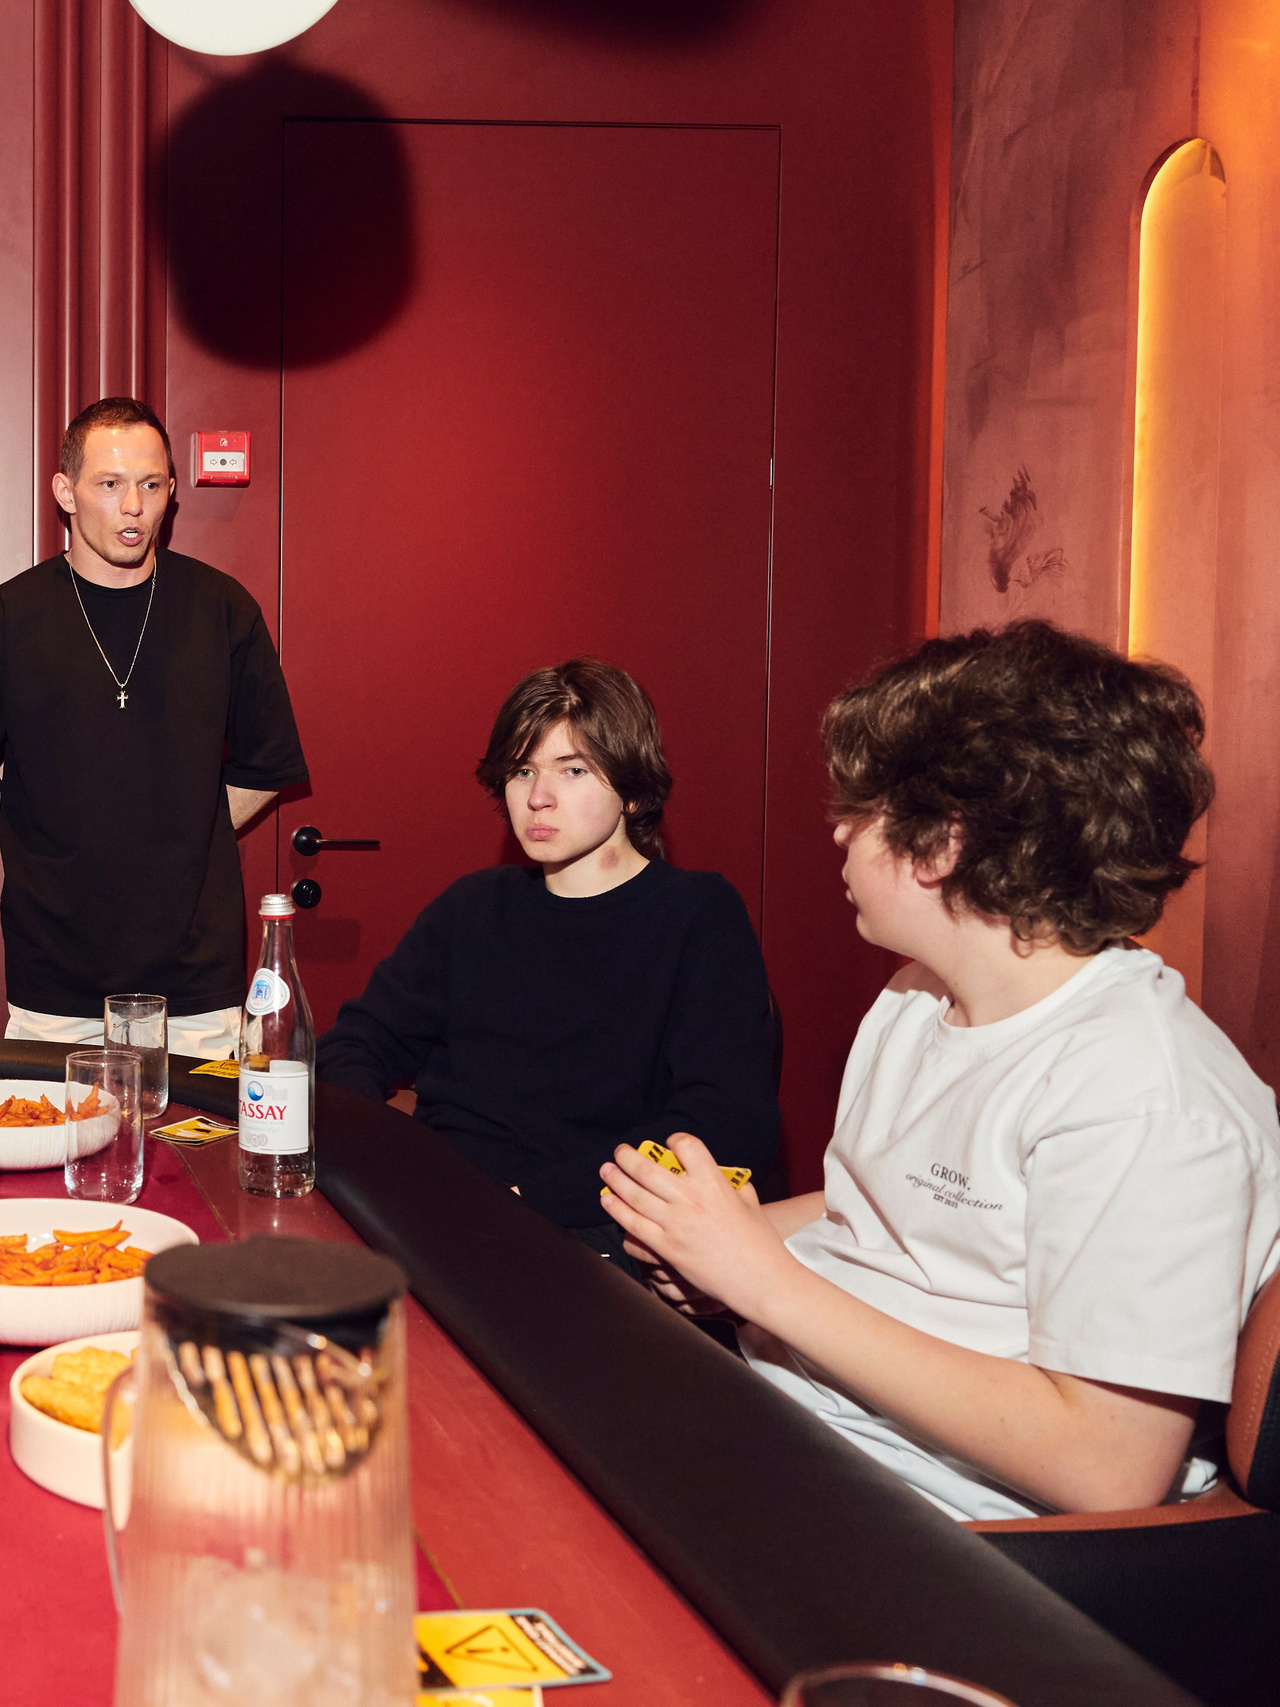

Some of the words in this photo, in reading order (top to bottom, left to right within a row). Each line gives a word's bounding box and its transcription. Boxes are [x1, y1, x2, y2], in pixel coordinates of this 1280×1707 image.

[905, 1173, 946, 1193] original
[944, 1191, 1003, 1210] collection
[931, 1163, 971, 1191] GROW.
